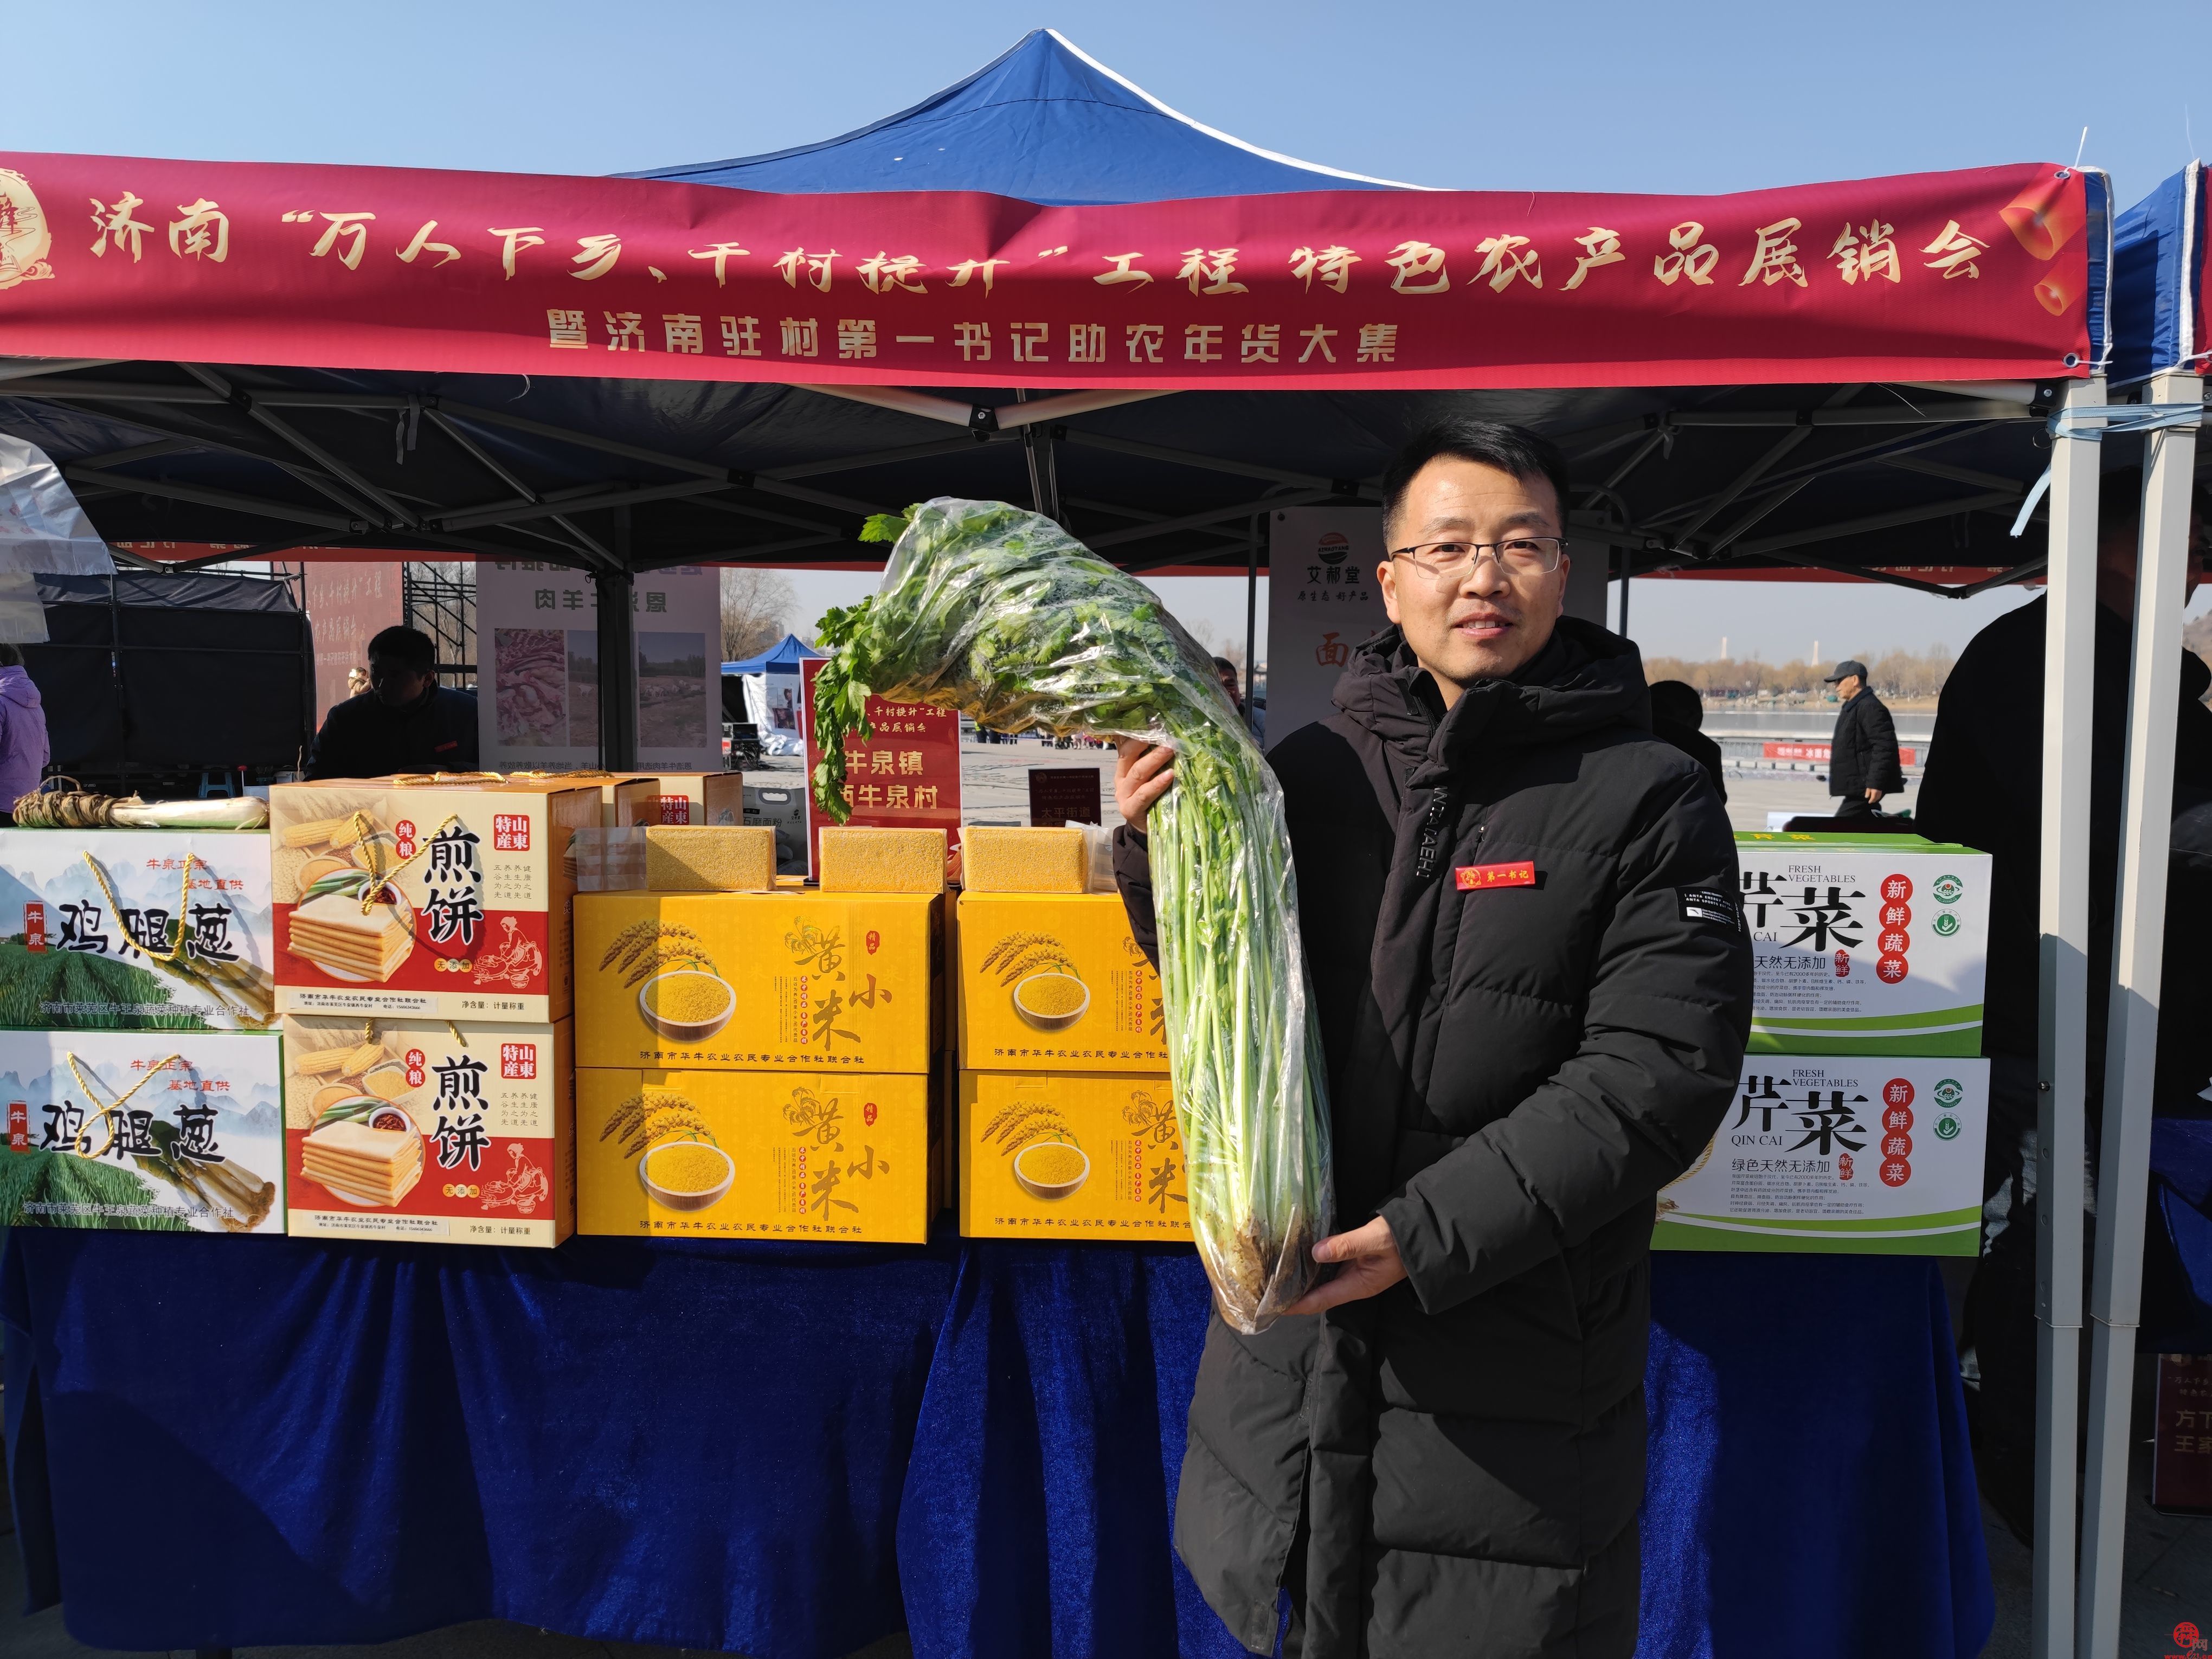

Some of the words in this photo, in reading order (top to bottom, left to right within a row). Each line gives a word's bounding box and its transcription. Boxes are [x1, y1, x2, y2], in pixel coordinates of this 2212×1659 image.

[550, 309, 1398, 364] 暨济南驻村第一书记助农年货大集
[1307, 565, 1360, 584] 艾郝堂
[1297, 590, 1330, 601] 原生态
[1335, 590, 1368, 601] 好产品
[845, 750, 923, 775] 牛泉镇
[1041, 807, 1091, 819] 太平街道
[398, 823, 414, 857] 纯粮
[512, 816, 529, 850] 山東
[1487, 870, 1529, 883] 第一书记
[1788, 865, 1821, 873] FRESH
[423, 826, 483, 946] 煎饼
[1788, 874, 1856, 883] VEGETABLES
[1739, 871, 1866, 952] 芹菜
[27, 911, 44, 946] 牛泉
[1882, 879, 1907, 979] 新鲜蔬菜
[867, 932, 876, 950] 精品
[1753, 931, 1777, 942] CAI
[436, 960, 471, 970] 无添加
[1754, 956, 1826, 970] 天然无添加
[1835, 952, 1850, 975] 新鲜
[461, 1000, 525, 1011] 净含量：计量称重
[639, 1050, 865, 1065] 济南市华牛农业农民专业合作社联合社
[994, 1048, 1168, 1059] 济南市华牛农业农民专业合作社
[130, 1059, 194, 1072] 牛泉正宗
[408, 1052, 423, 1085] 纯粮
[519, 1045, 535, 1078] 山東
[1792, 1069, 1825, 1078] FRESH
[168, 1079, 230, 1092] 基地直供
[1792, 1078, 1859, 1088] VEGETABLES
[432, 1054, 489, 1171] 煎饼
[866, 1105, 874, 1123] 精品
[1732, 1075, 1869, 1156] 芹菜
[10, 1110, 28, 1146] 牛泉
[1885, 1084, 1908, 1182] 新鲜蔬菜
[1731, 1135, 1757, 1147] QIN
[1759, 1135, 1783, 1146] CAI
[1131, 1099, 1188, 1214] 黄米
[1732, 1159, 1830, 1173] 绿色天然无添加
[1839, 1156, 1854, 1179] 新鲜
[445, 1186, 478, 1196] 无添加
[470, 1225, 531, 1236] 净含量：计量称重
[639, 1220, 863, 1234] 济南市华牛农业农民专业合作社联合社
[2168, 1377, 2212, 1386] “万人下乡
